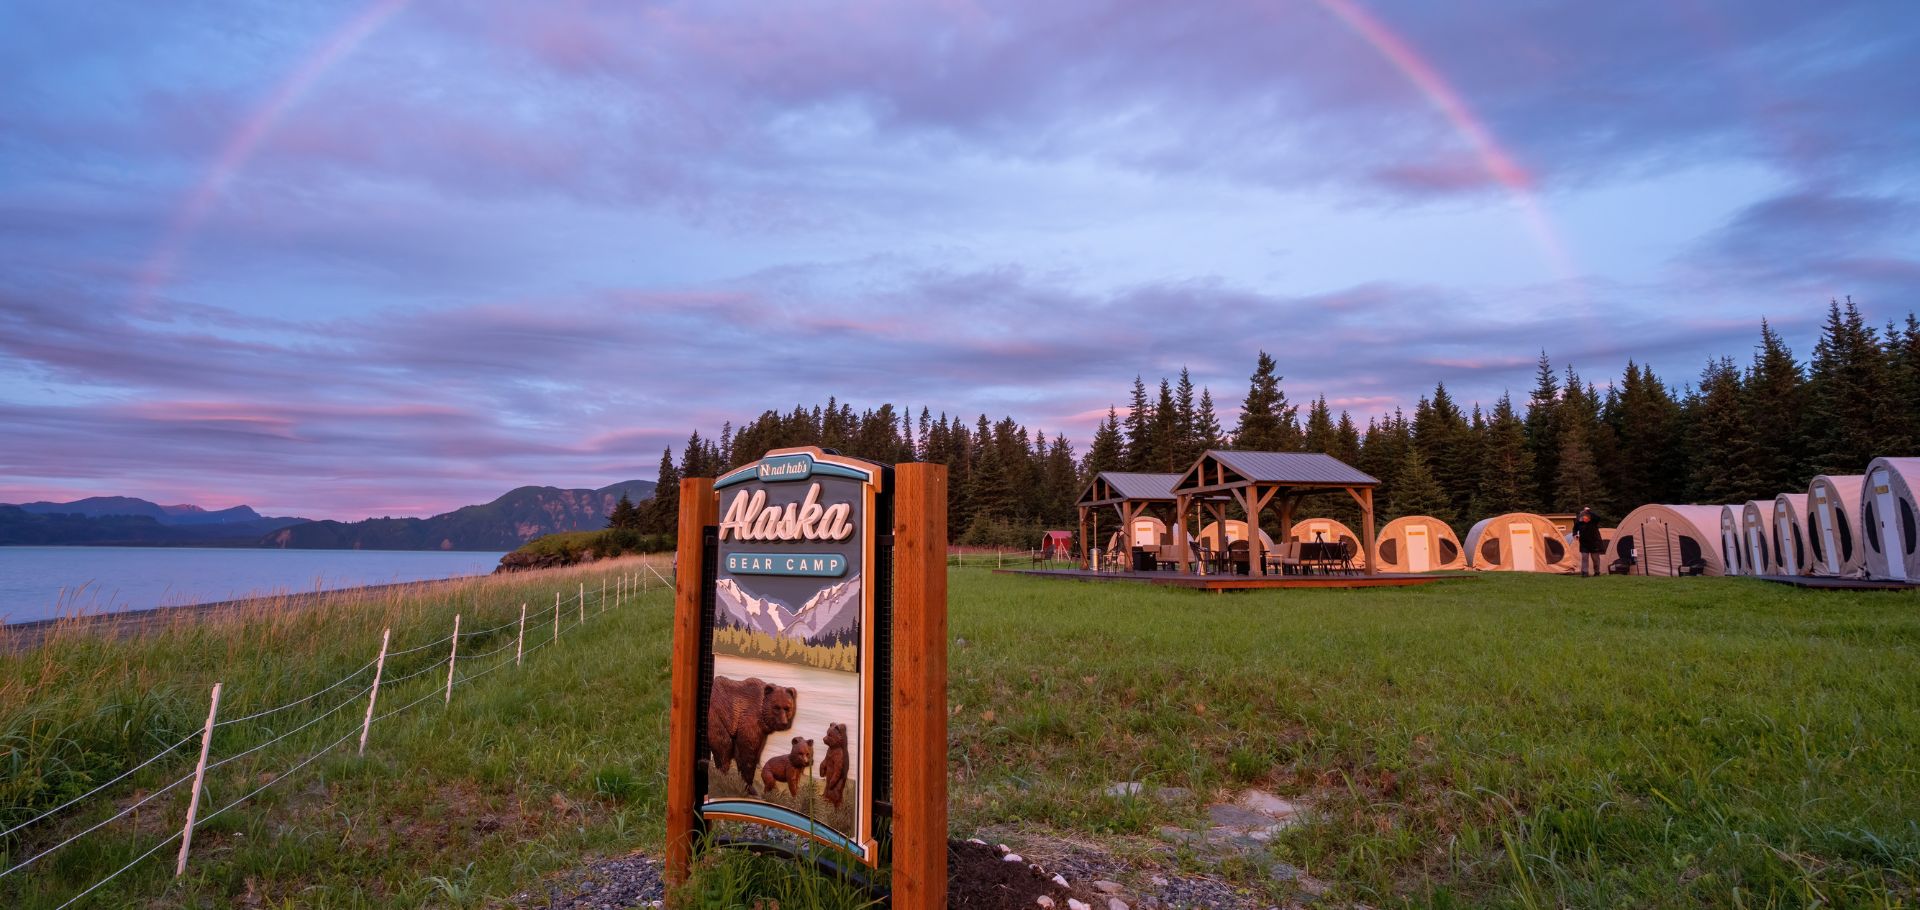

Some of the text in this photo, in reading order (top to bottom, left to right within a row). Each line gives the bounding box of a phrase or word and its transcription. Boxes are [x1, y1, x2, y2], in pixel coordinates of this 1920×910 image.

[771, 463, 785, 475] nat
[786, 460, 807, 474] hab's
[719, 483, 853, 541] Alaska
[730, 558, 838, 572] BEAR CAMP
